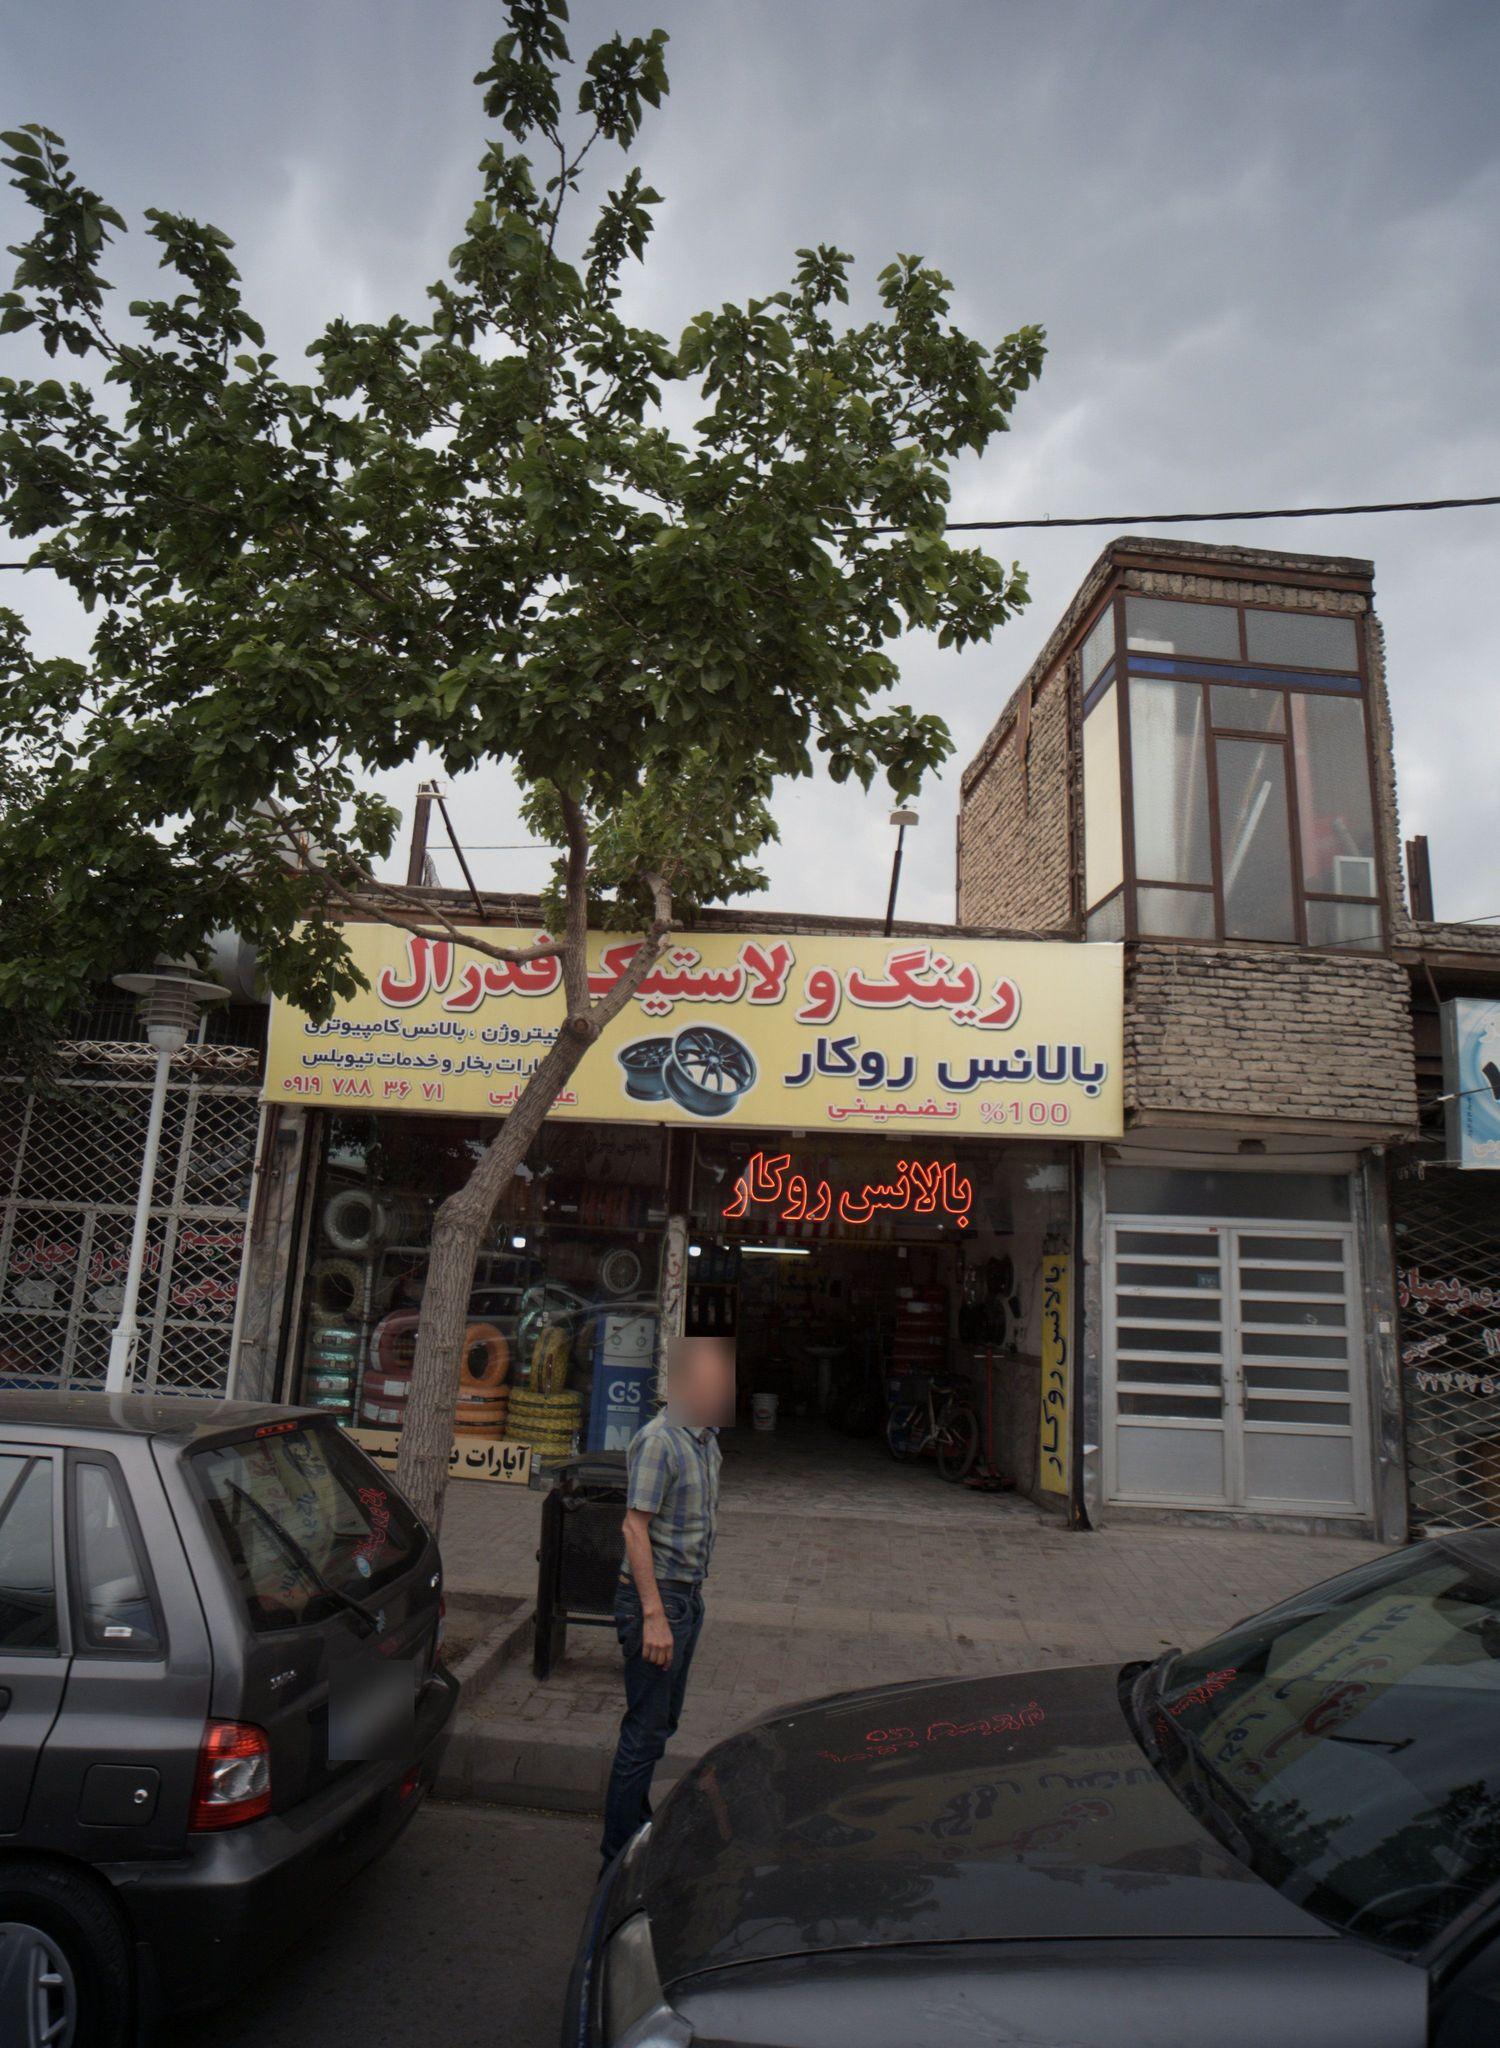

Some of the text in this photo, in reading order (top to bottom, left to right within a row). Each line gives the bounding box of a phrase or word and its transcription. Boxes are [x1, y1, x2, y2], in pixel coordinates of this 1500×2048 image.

[378, 932, 1021, 1028] رینگ و لاستیک فدرال
[304, 1018, 400, 1040] کامپیوتری
[402, 1021, 466, 1041] بالانس
[301, 1048, 375, 1070] تیوبلس
[376, 1051, 439, 1069] خدمات
[440, 1057, 453, 1074] و
[455, 1054, 493, 1076] بخار
[783, 1035, 1108, 1097] بالانس روکار
[825, 1095, 959, 1121] تضمینی
[722, 1150, 974, 1232] بالانس روکار
[1041, 1264, 1068, 1479] بالانس روکار
[607, 1379, 642, 1405] G5
[465, 1444, 530, 1480] آپارات
